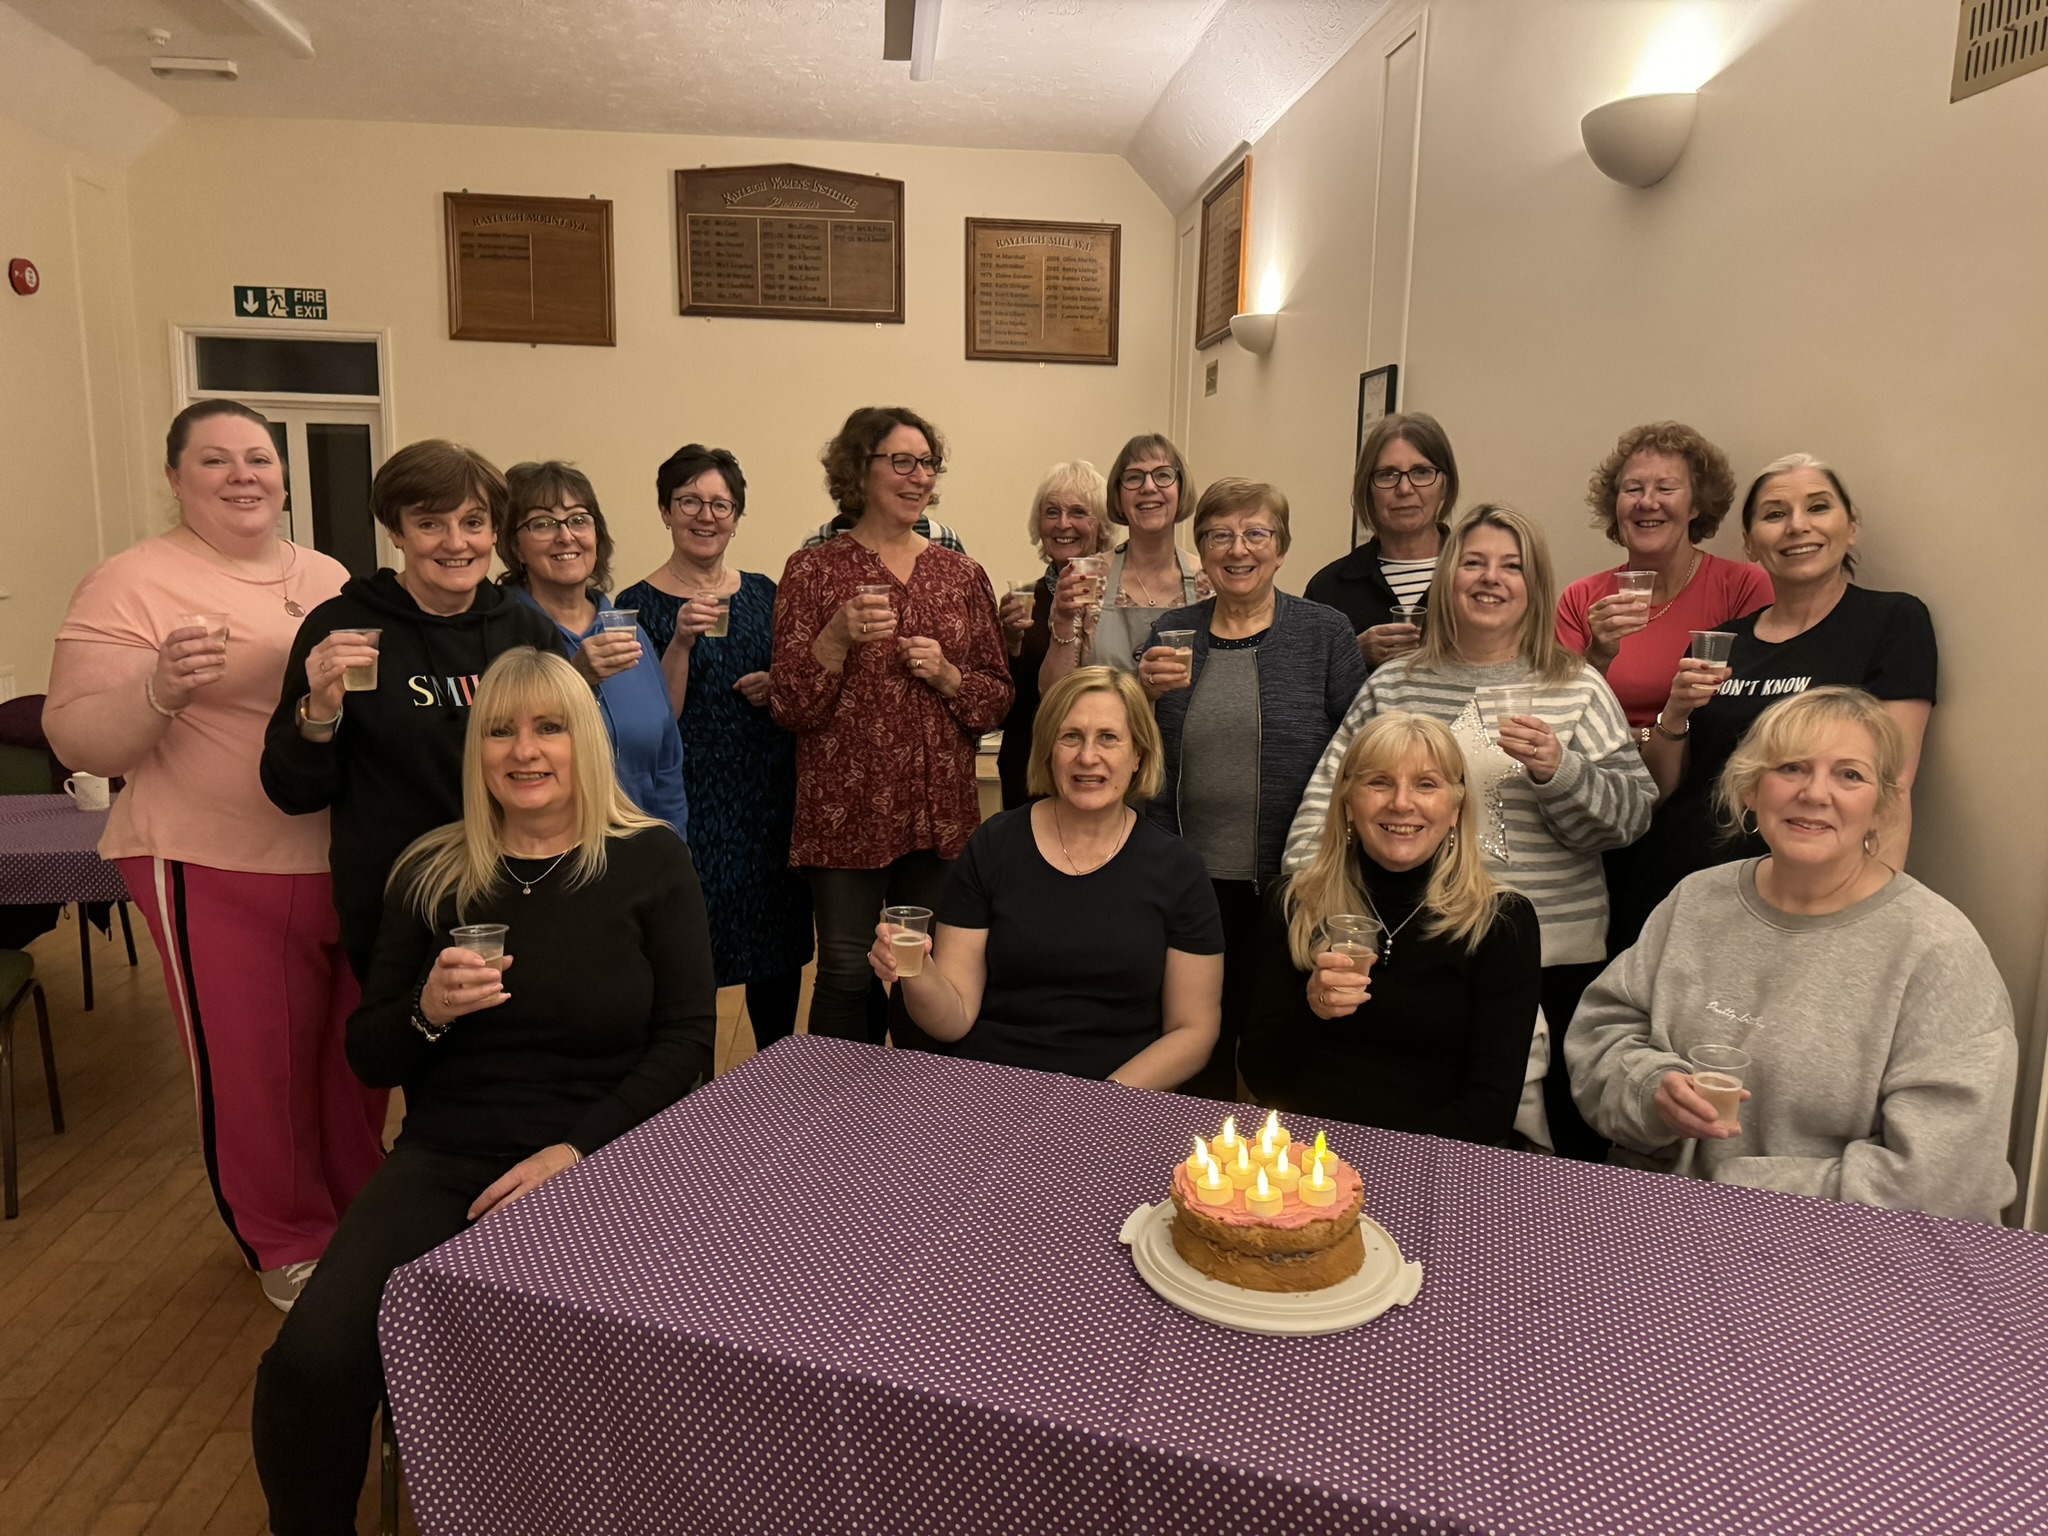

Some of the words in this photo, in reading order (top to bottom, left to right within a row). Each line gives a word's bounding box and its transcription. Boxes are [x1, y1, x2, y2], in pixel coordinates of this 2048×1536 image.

[721, 181, 768, 206] RAYLEIGH
[812, 179, 859, 210] INSTITUTE
[473, 213, 525, 228] RAYLEIGH
[527, 214, 568, 228] MOUNT
[996, 236, 1047, 249] RAYLEIGH
[1048, 236, 1074, 249] MILL
[294, 290, 324, 303] FIRE
[295, 305, 325, 318] EXIT
[1760, 676, 1812, 696] KNOW
